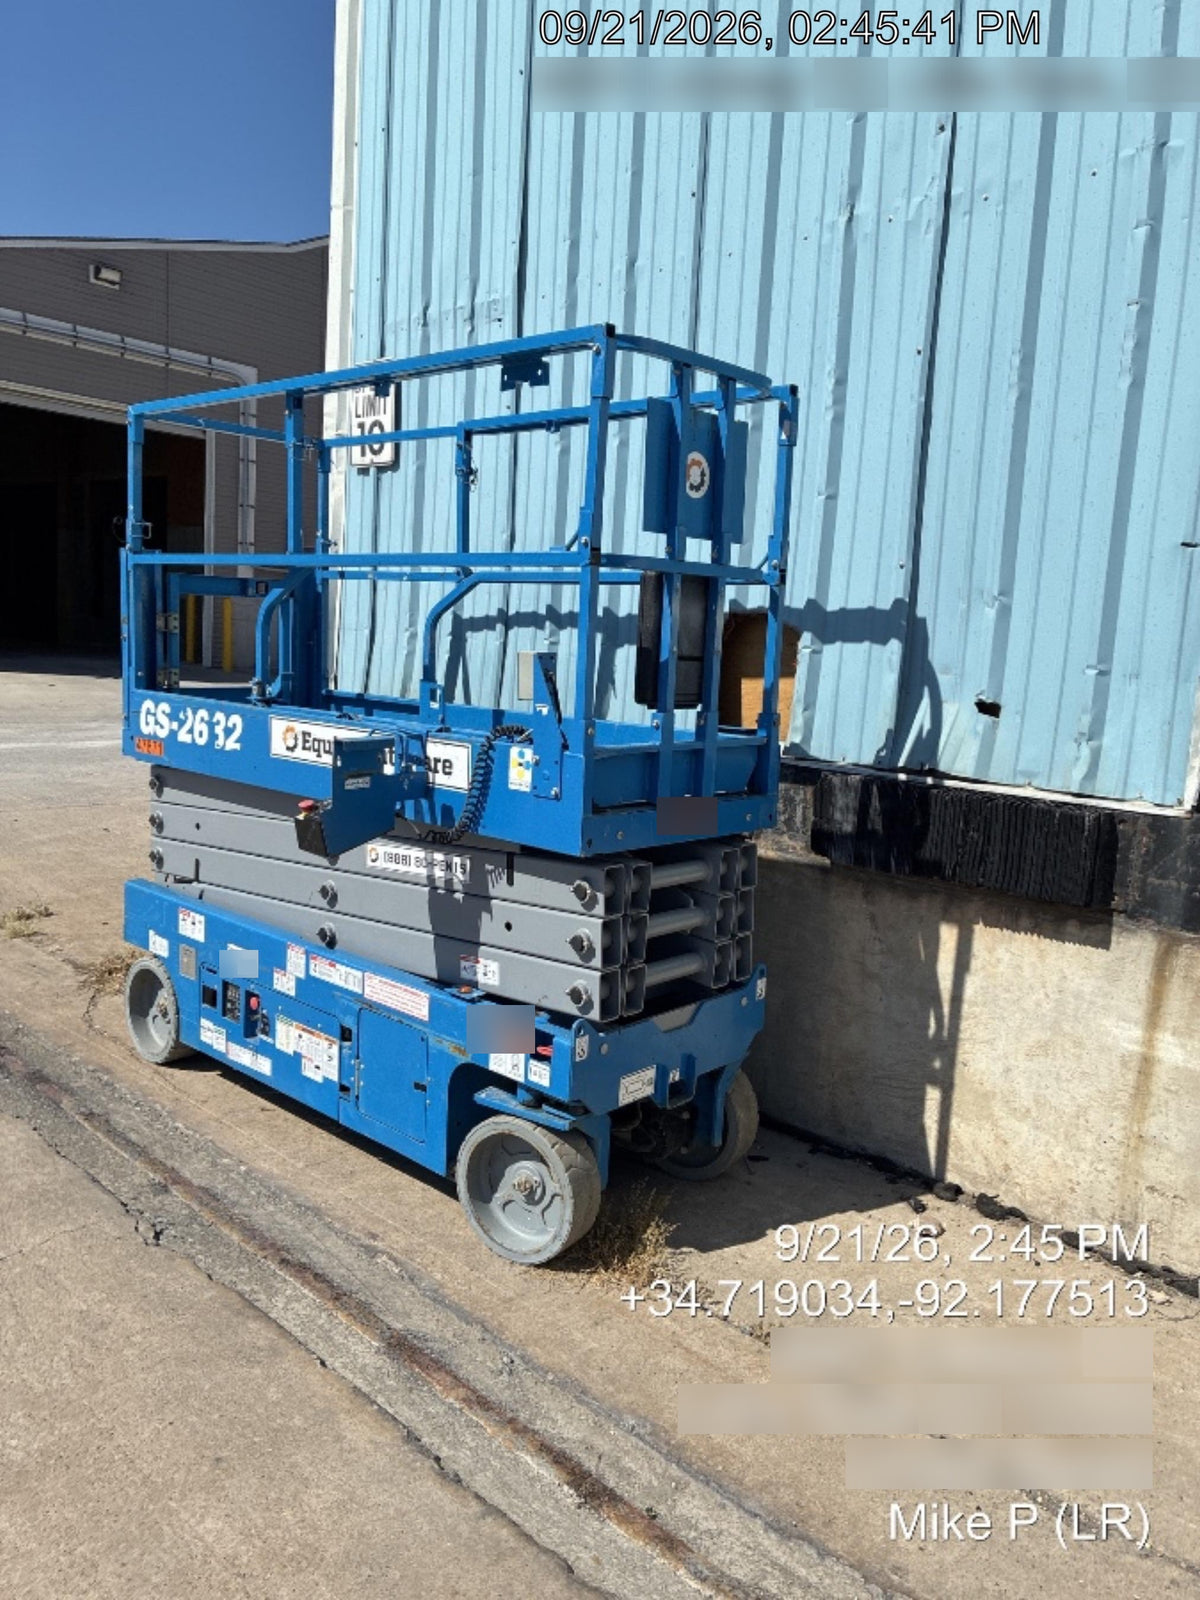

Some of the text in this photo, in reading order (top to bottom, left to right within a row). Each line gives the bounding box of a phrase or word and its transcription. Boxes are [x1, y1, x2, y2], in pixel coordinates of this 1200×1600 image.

[355, 392, 388, 419] LIMIT
[357, 419, 385, 458] 10
[139, 698, 243, 751] GS-2632
